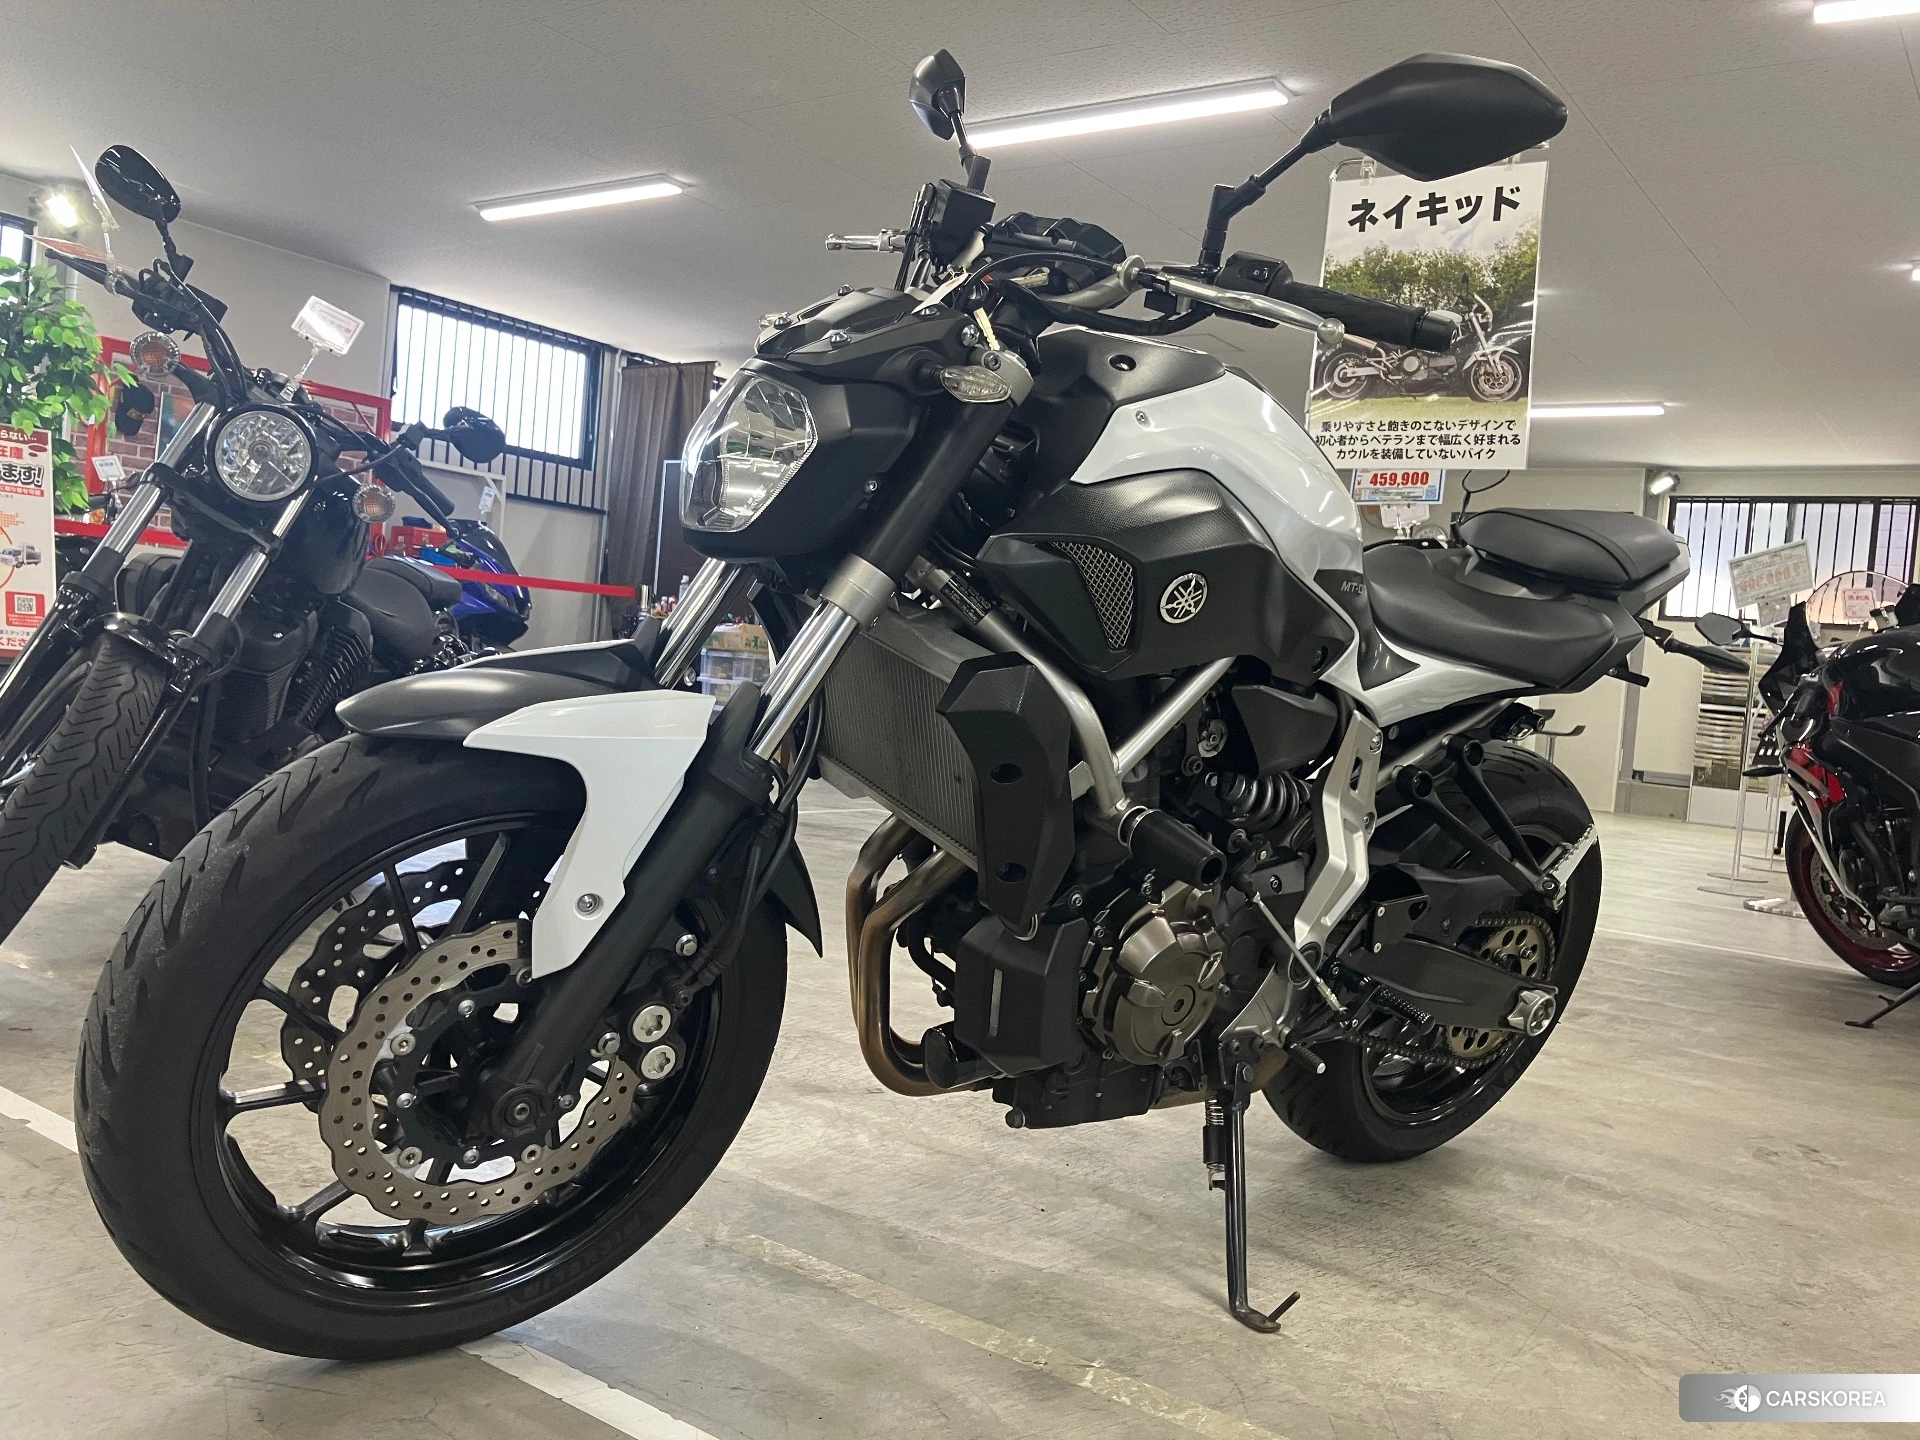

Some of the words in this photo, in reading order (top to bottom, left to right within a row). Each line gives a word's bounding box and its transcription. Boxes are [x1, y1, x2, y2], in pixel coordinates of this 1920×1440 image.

[1347, 186, 1521, 233] ネイキッド
[1320, 420, 1517, 432] 乗りやすさと飽きのこないデザインで
[1336, 448, 1496, 460] カウルを装備していないバイク
[0, 463, 44, 487] ます!
[1369, 471, 1430, 487] 459,900
